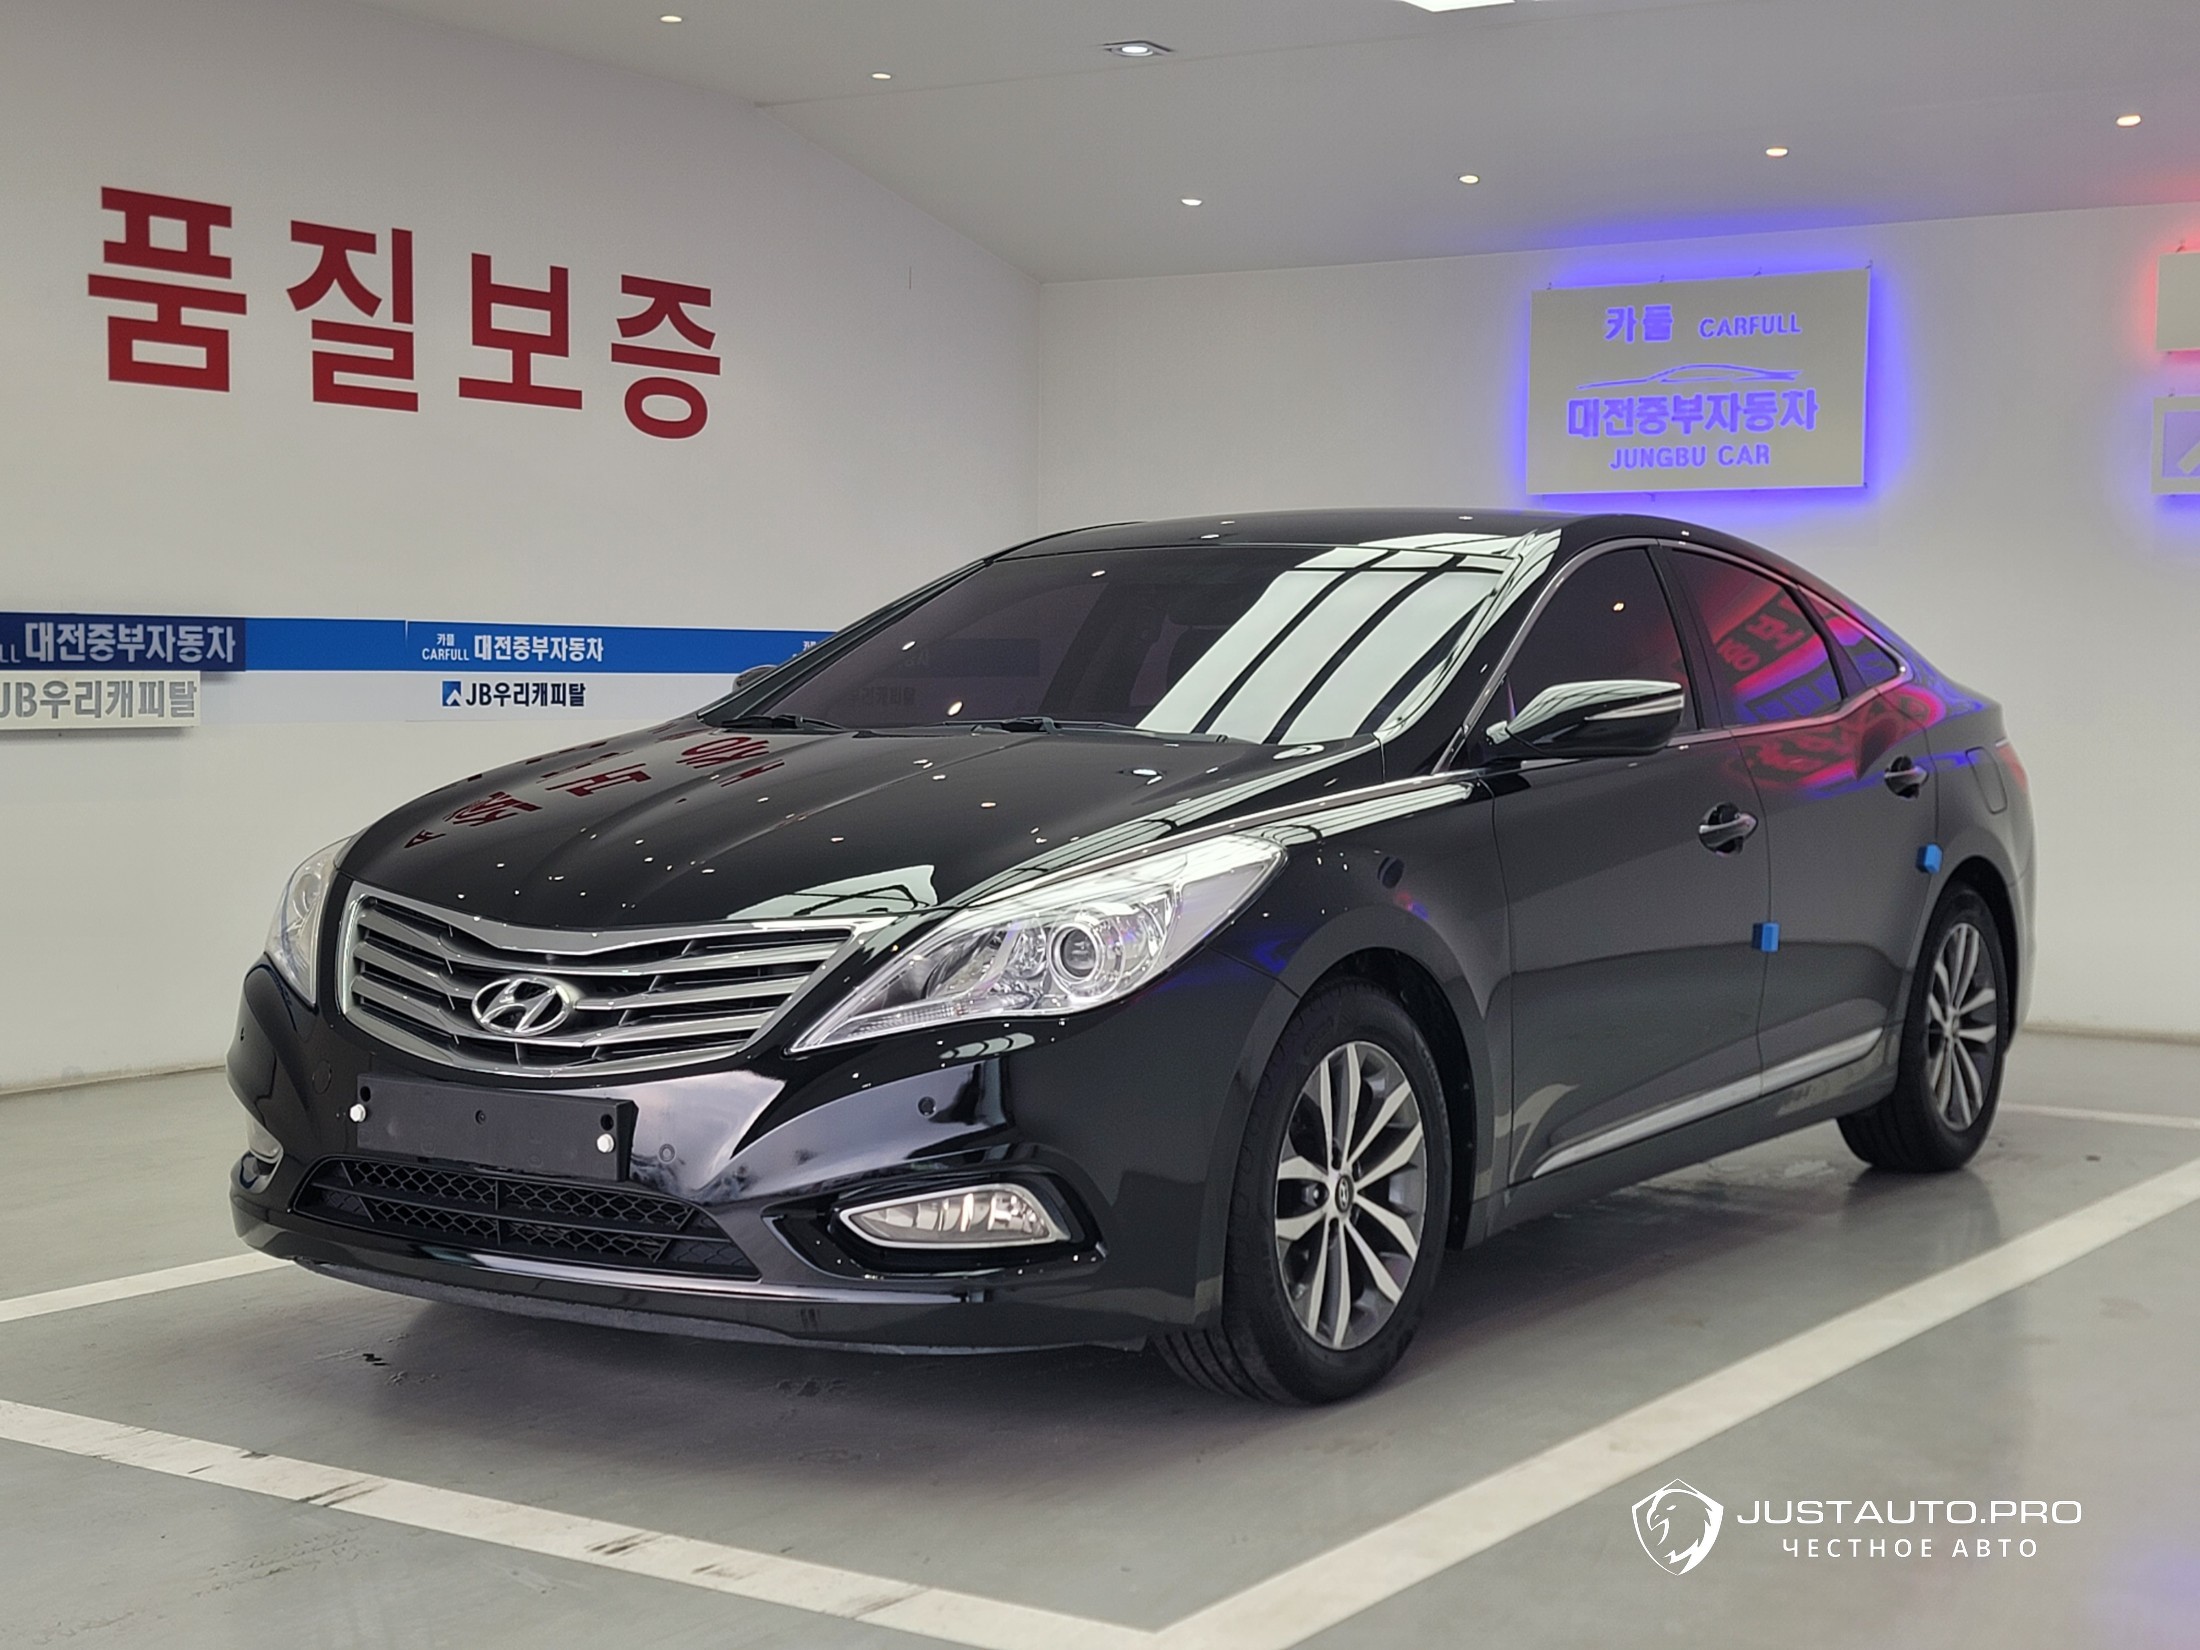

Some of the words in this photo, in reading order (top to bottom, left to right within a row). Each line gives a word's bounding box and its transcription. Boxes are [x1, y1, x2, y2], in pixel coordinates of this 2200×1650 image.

[88, 186, 721, 440] 품질보증
[1698, 314, 1802, 339] CARFULL
[1568, 388, 1820, 438] 대전중부자동차
[1610, 445, 1707, 470] JUNGBU
[1718, 444, 1771, 466] CAR
[25, 622, 236, 663] 대전중부자동차
[421, 648, 469, 661] CARFULL
[474, 634, 604, 662] 대전중부자동차
[465, 682, 586, 707] JB우리캐피탈
